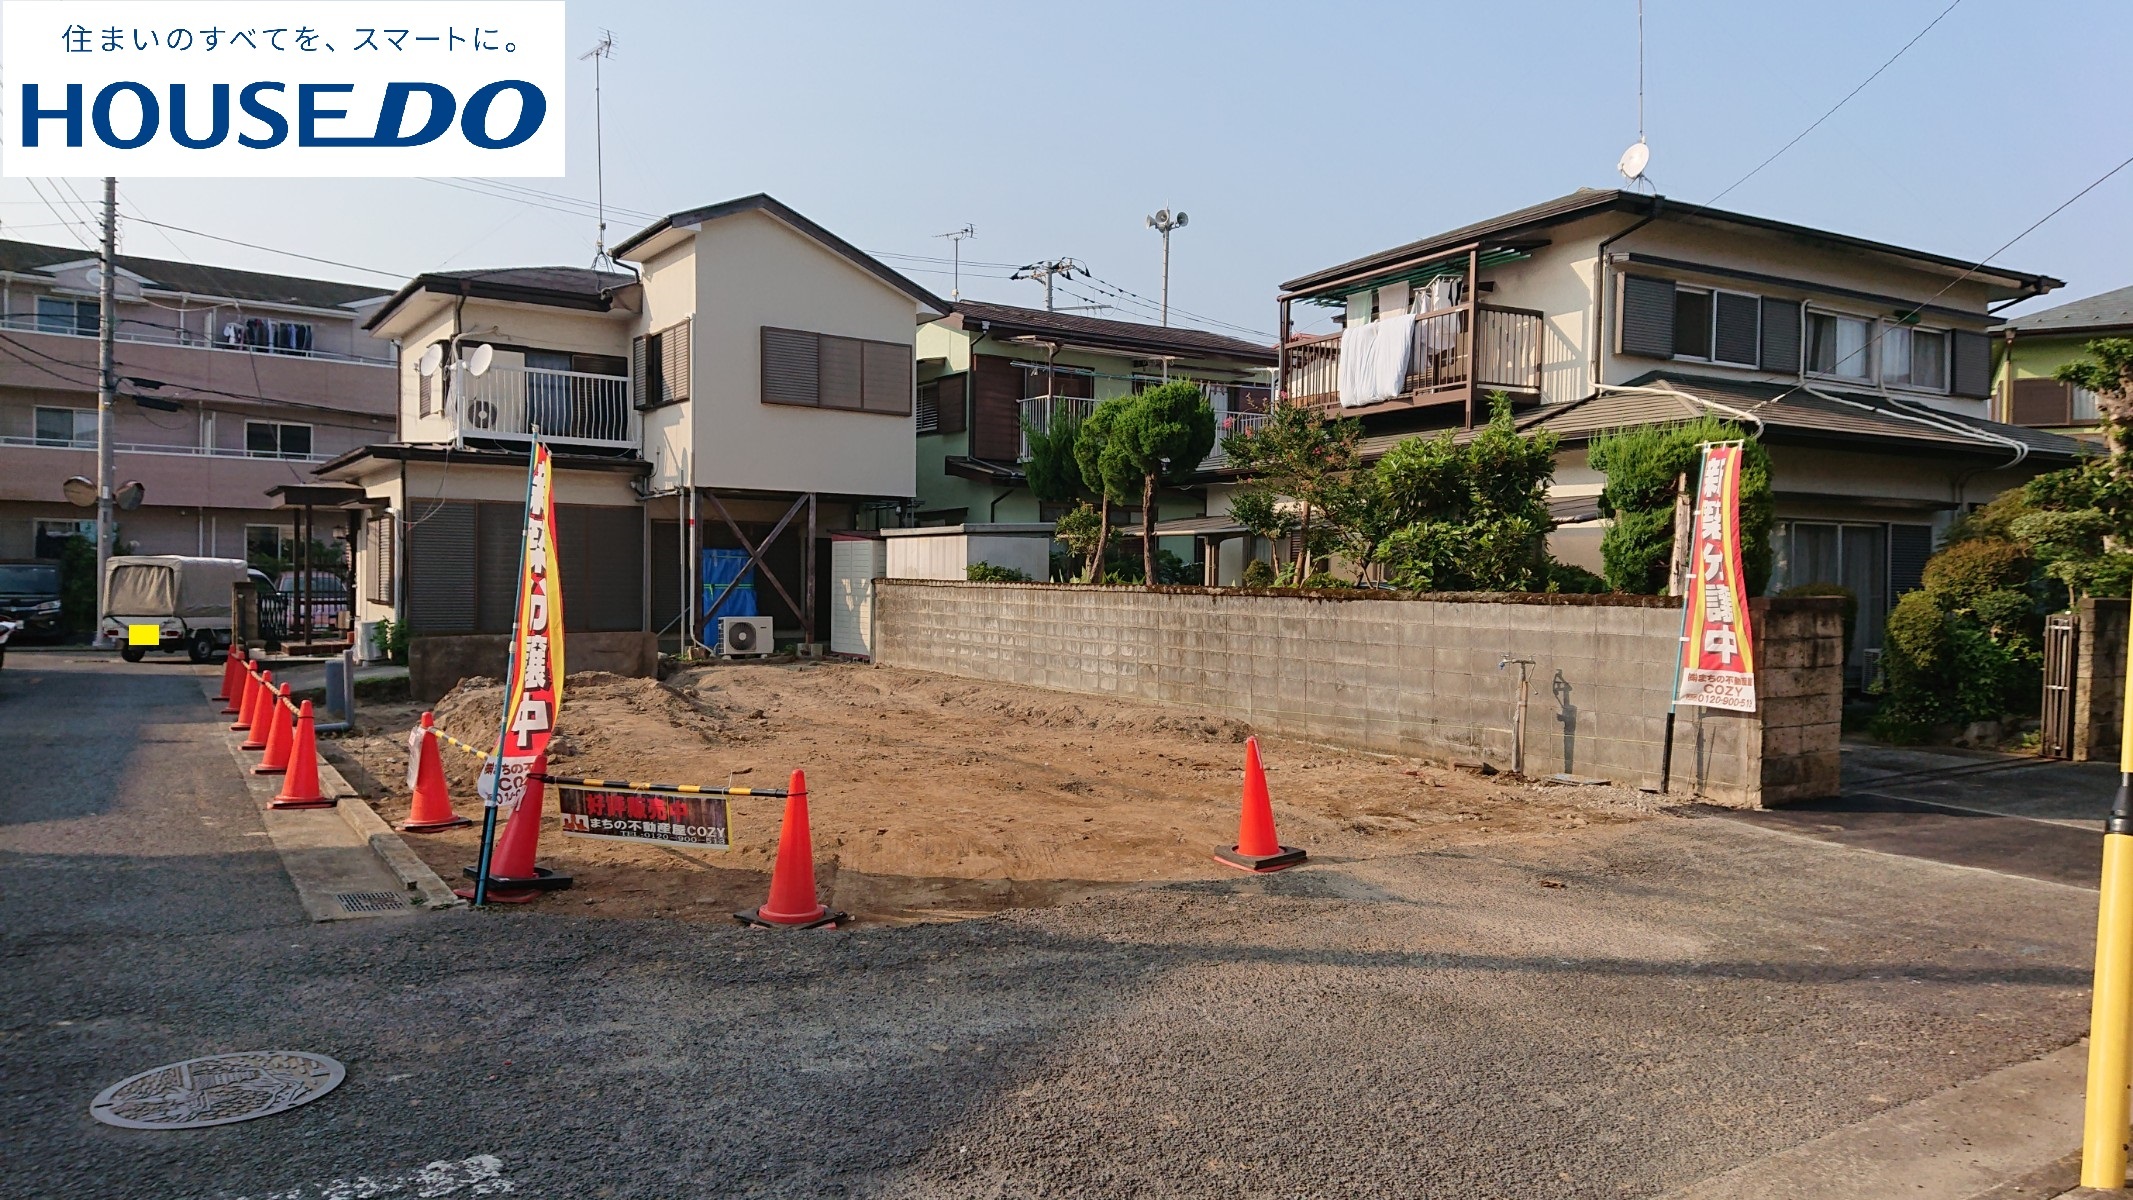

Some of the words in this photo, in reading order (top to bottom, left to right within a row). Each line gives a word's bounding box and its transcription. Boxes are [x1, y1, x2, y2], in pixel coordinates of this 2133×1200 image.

[1702, 457, 1738, 664] 新築分譲中
[1703, 684, 1743, 697] COZY
[586, 793, 689, 823] 好評販売中
